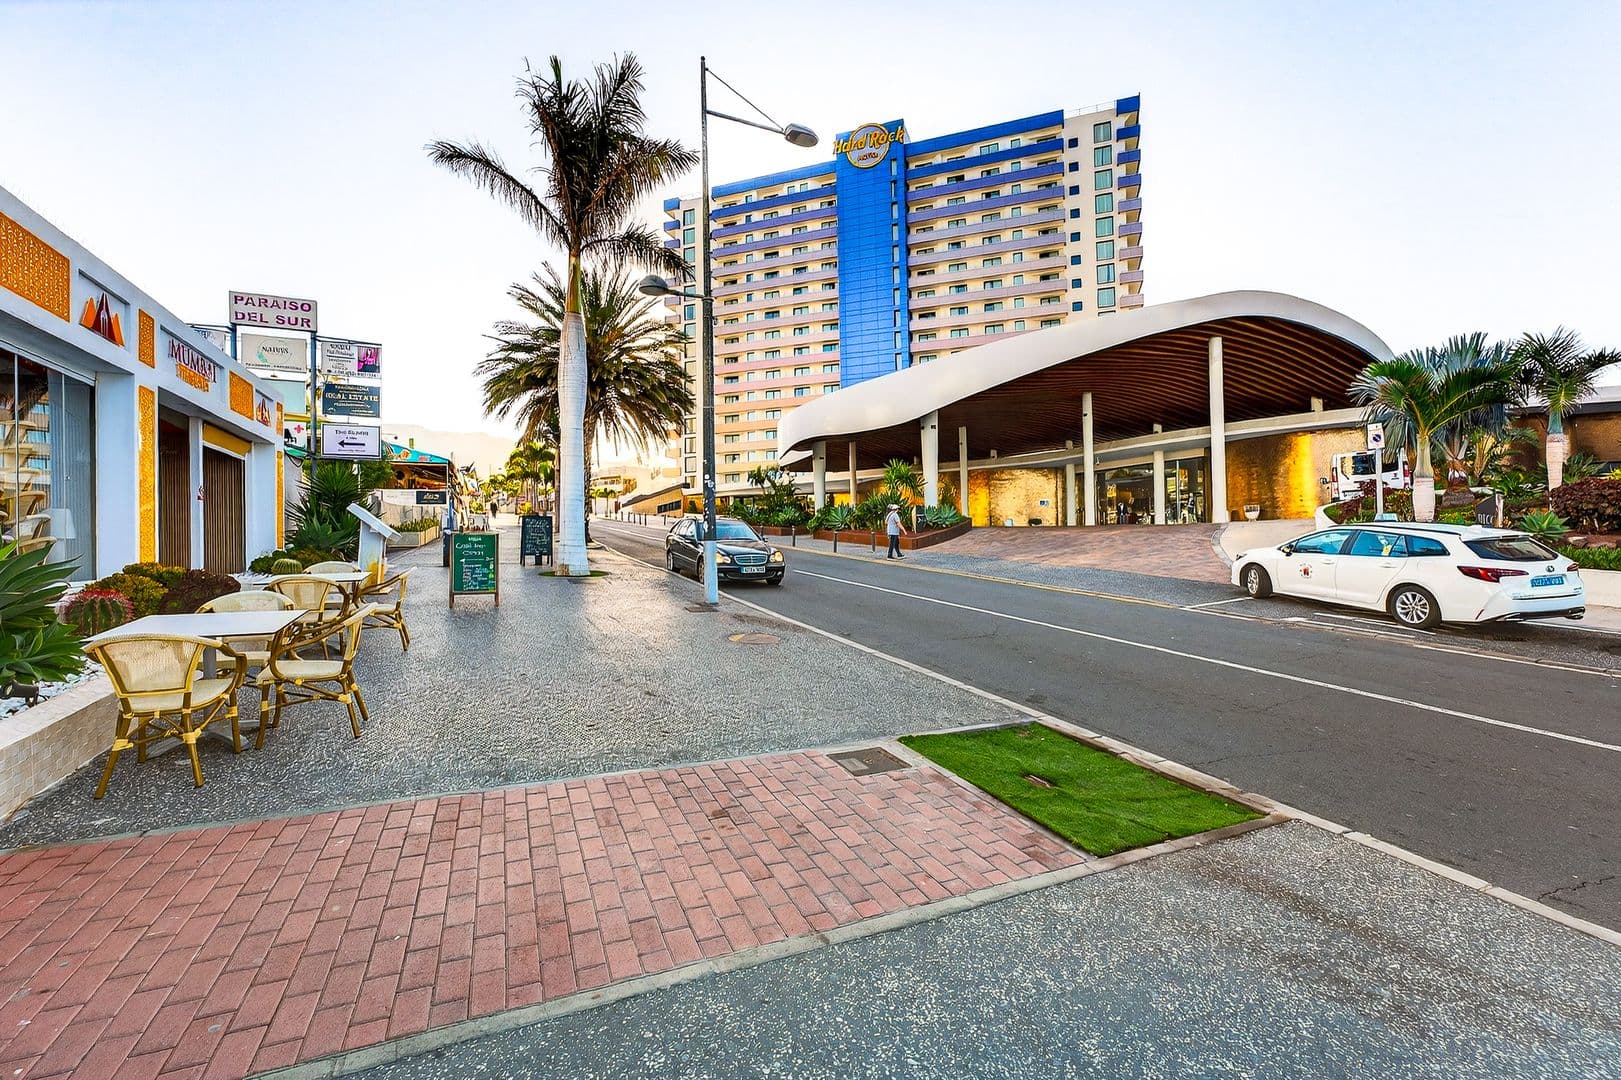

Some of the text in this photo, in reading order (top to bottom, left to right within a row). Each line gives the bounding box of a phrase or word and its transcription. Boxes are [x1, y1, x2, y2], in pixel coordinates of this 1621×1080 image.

[833, 126, 904, 154] Hard Rock
[234, 295, 312, 312] PARAISO
[234, 311, 311, 328] DEL SUR
[168, 338, 217, 383] MUMBAI
